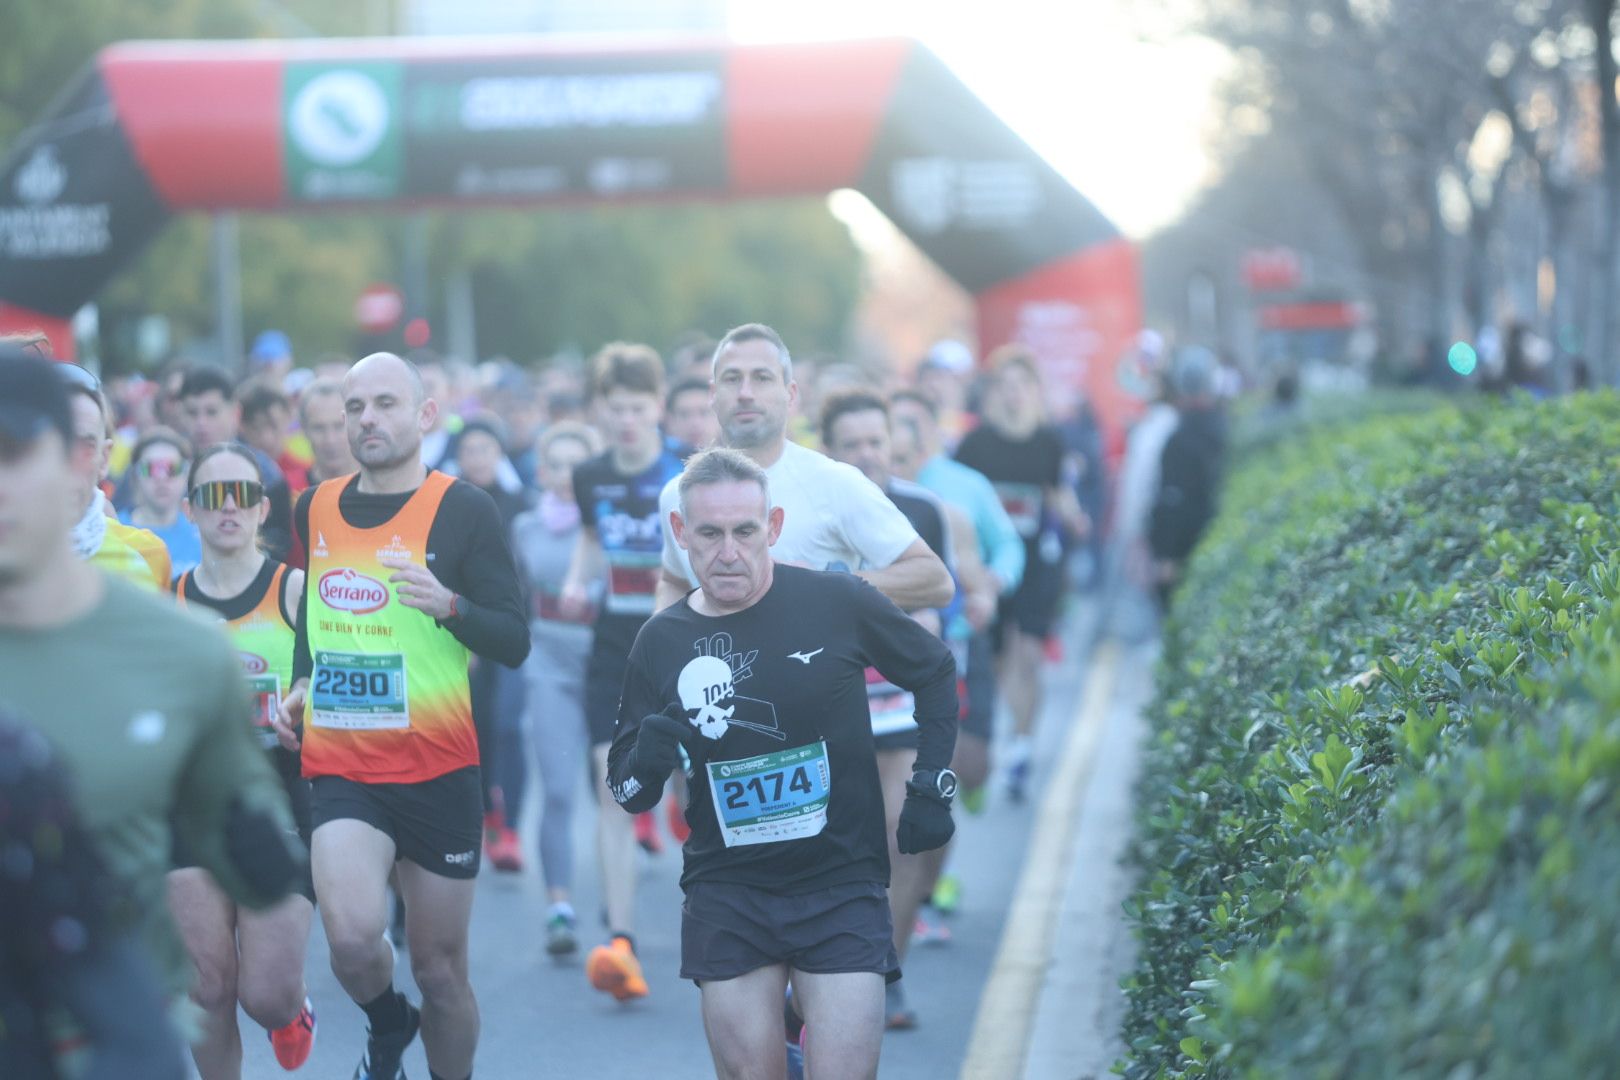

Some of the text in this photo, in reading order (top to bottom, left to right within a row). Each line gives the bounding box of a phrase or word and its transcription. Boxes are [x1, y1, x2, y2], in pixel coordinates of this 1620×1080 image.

[323, 578, 383, 603] Serrano
[335, 621, 353, 634] BIEN
[356, 624, 362, 635] Y
[365, 624, 394, 637] CORRE
[315, 668, 390, 697] 2290
[723, 766, 813, 810] 2174
